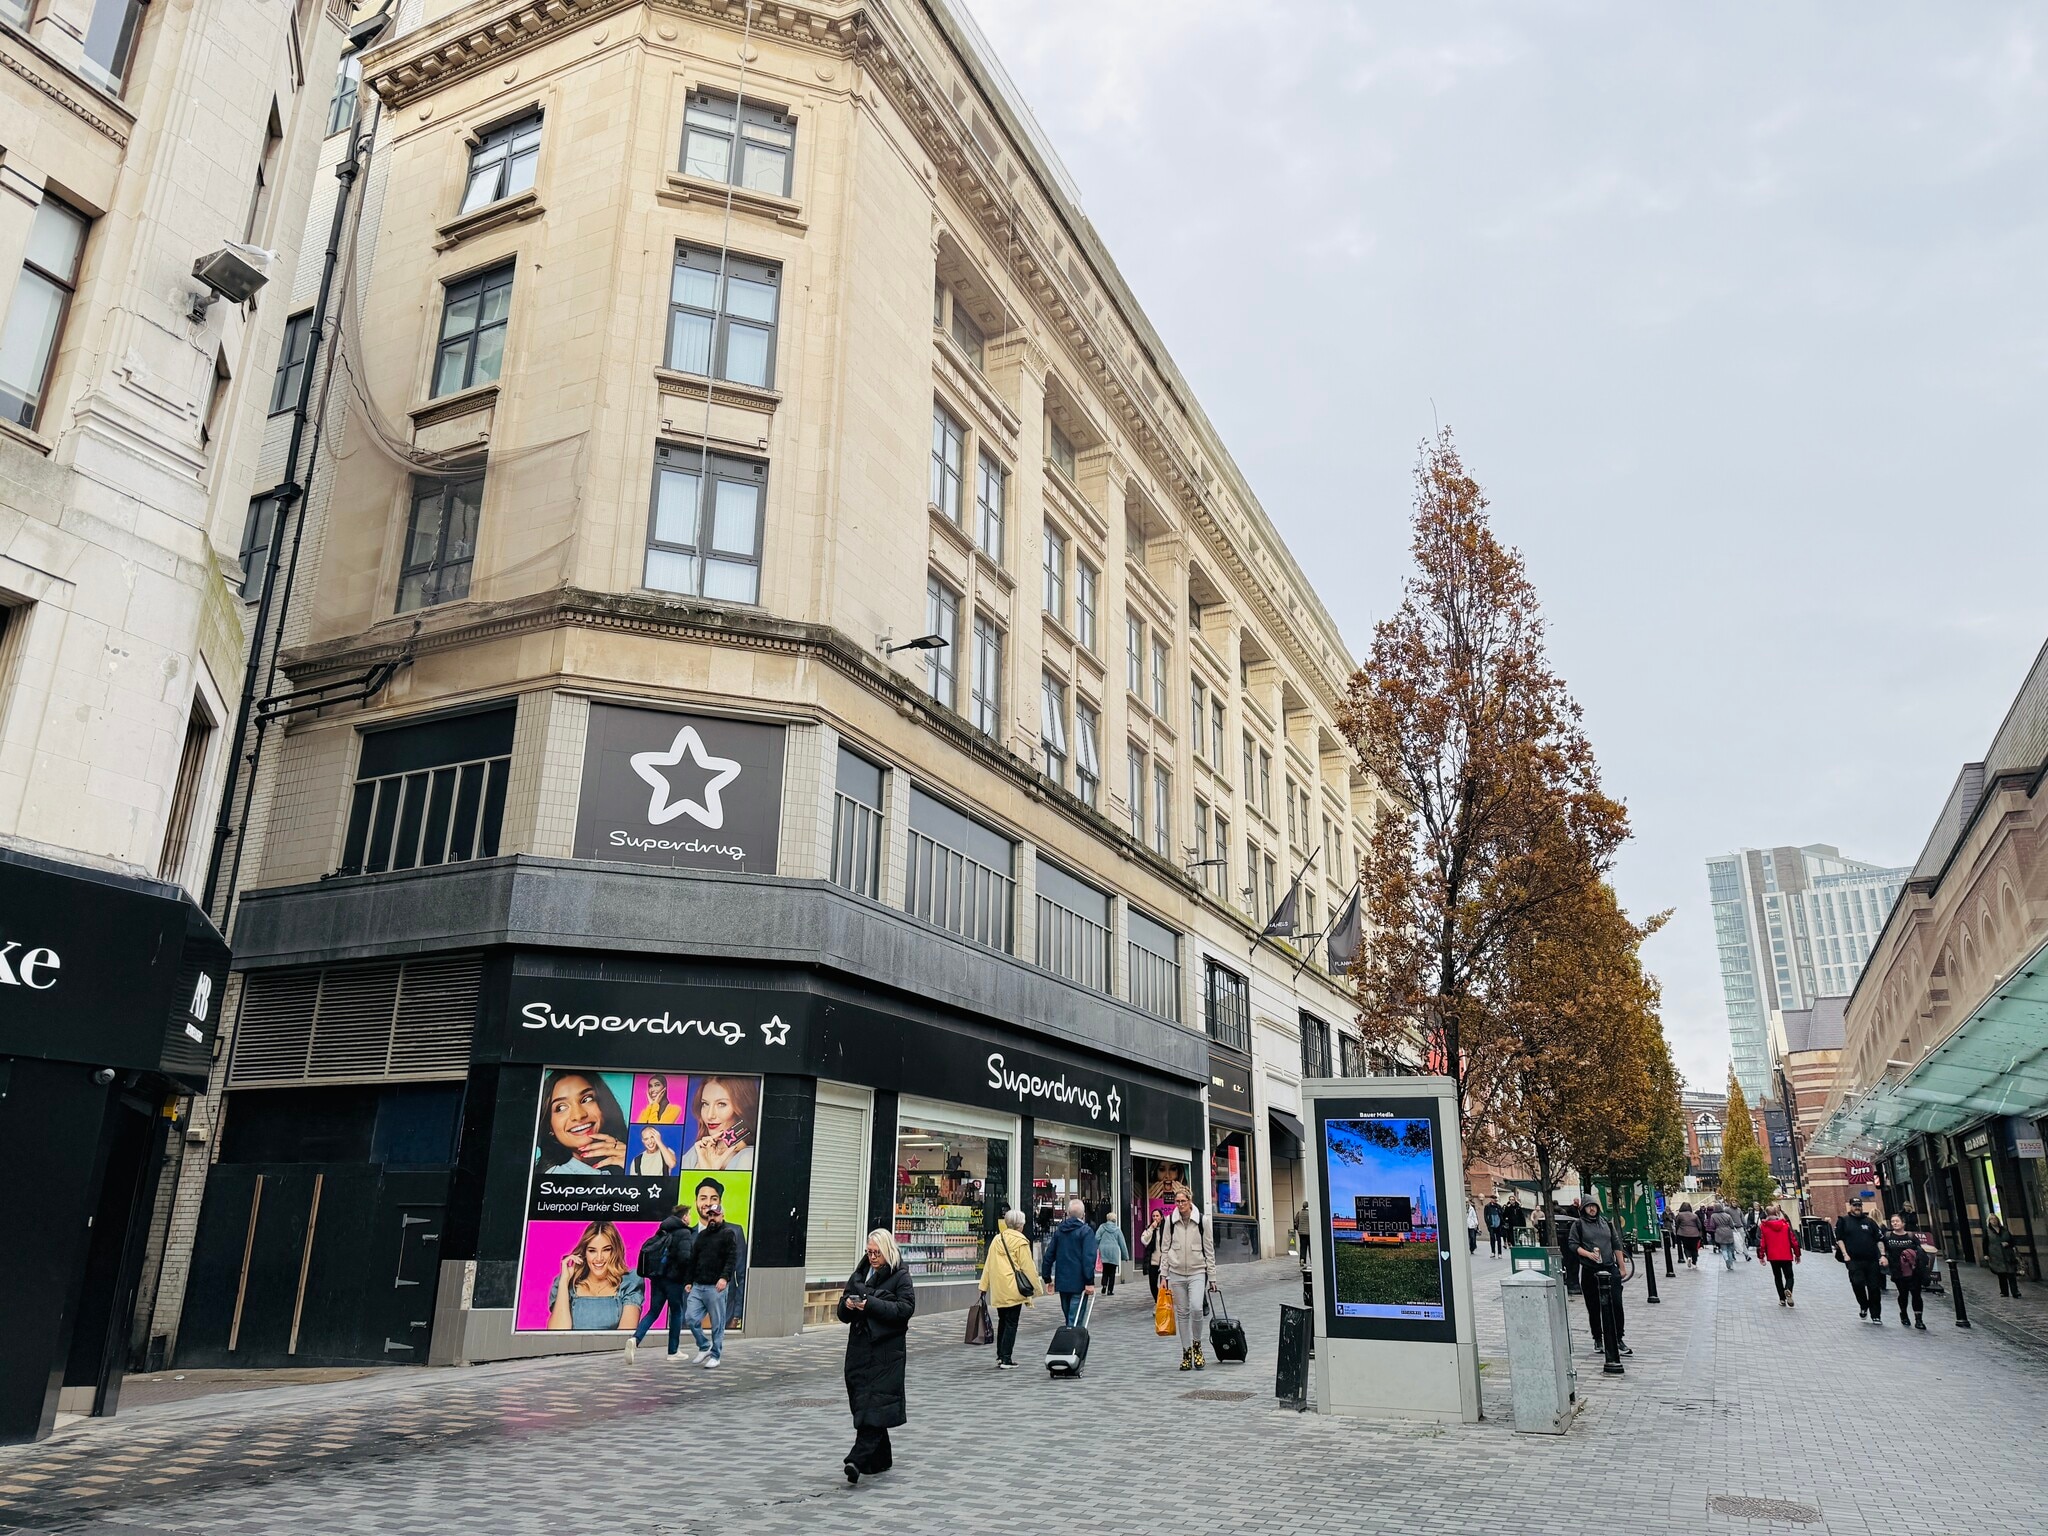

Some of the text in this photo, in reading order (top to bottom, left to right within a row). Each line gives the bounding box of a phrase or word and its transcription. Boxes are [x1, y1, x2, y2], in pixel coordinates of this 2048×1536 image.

[609, 831, 746, 861] Superdrug
[521, 1002, 746, 1046] Superdrug
[987, 1052, 1102, 1121] Superdrug
[540, 1181, 641, 1199] Superdrug
[537, 1201, 640, 1213] Liverpool Parker Street
[1356, 1197, 1392, 1207] WE ARE
[1357, 1209, 1378, 1219] THE
[1358, 1221, 1410, 1232] ASTEROID
